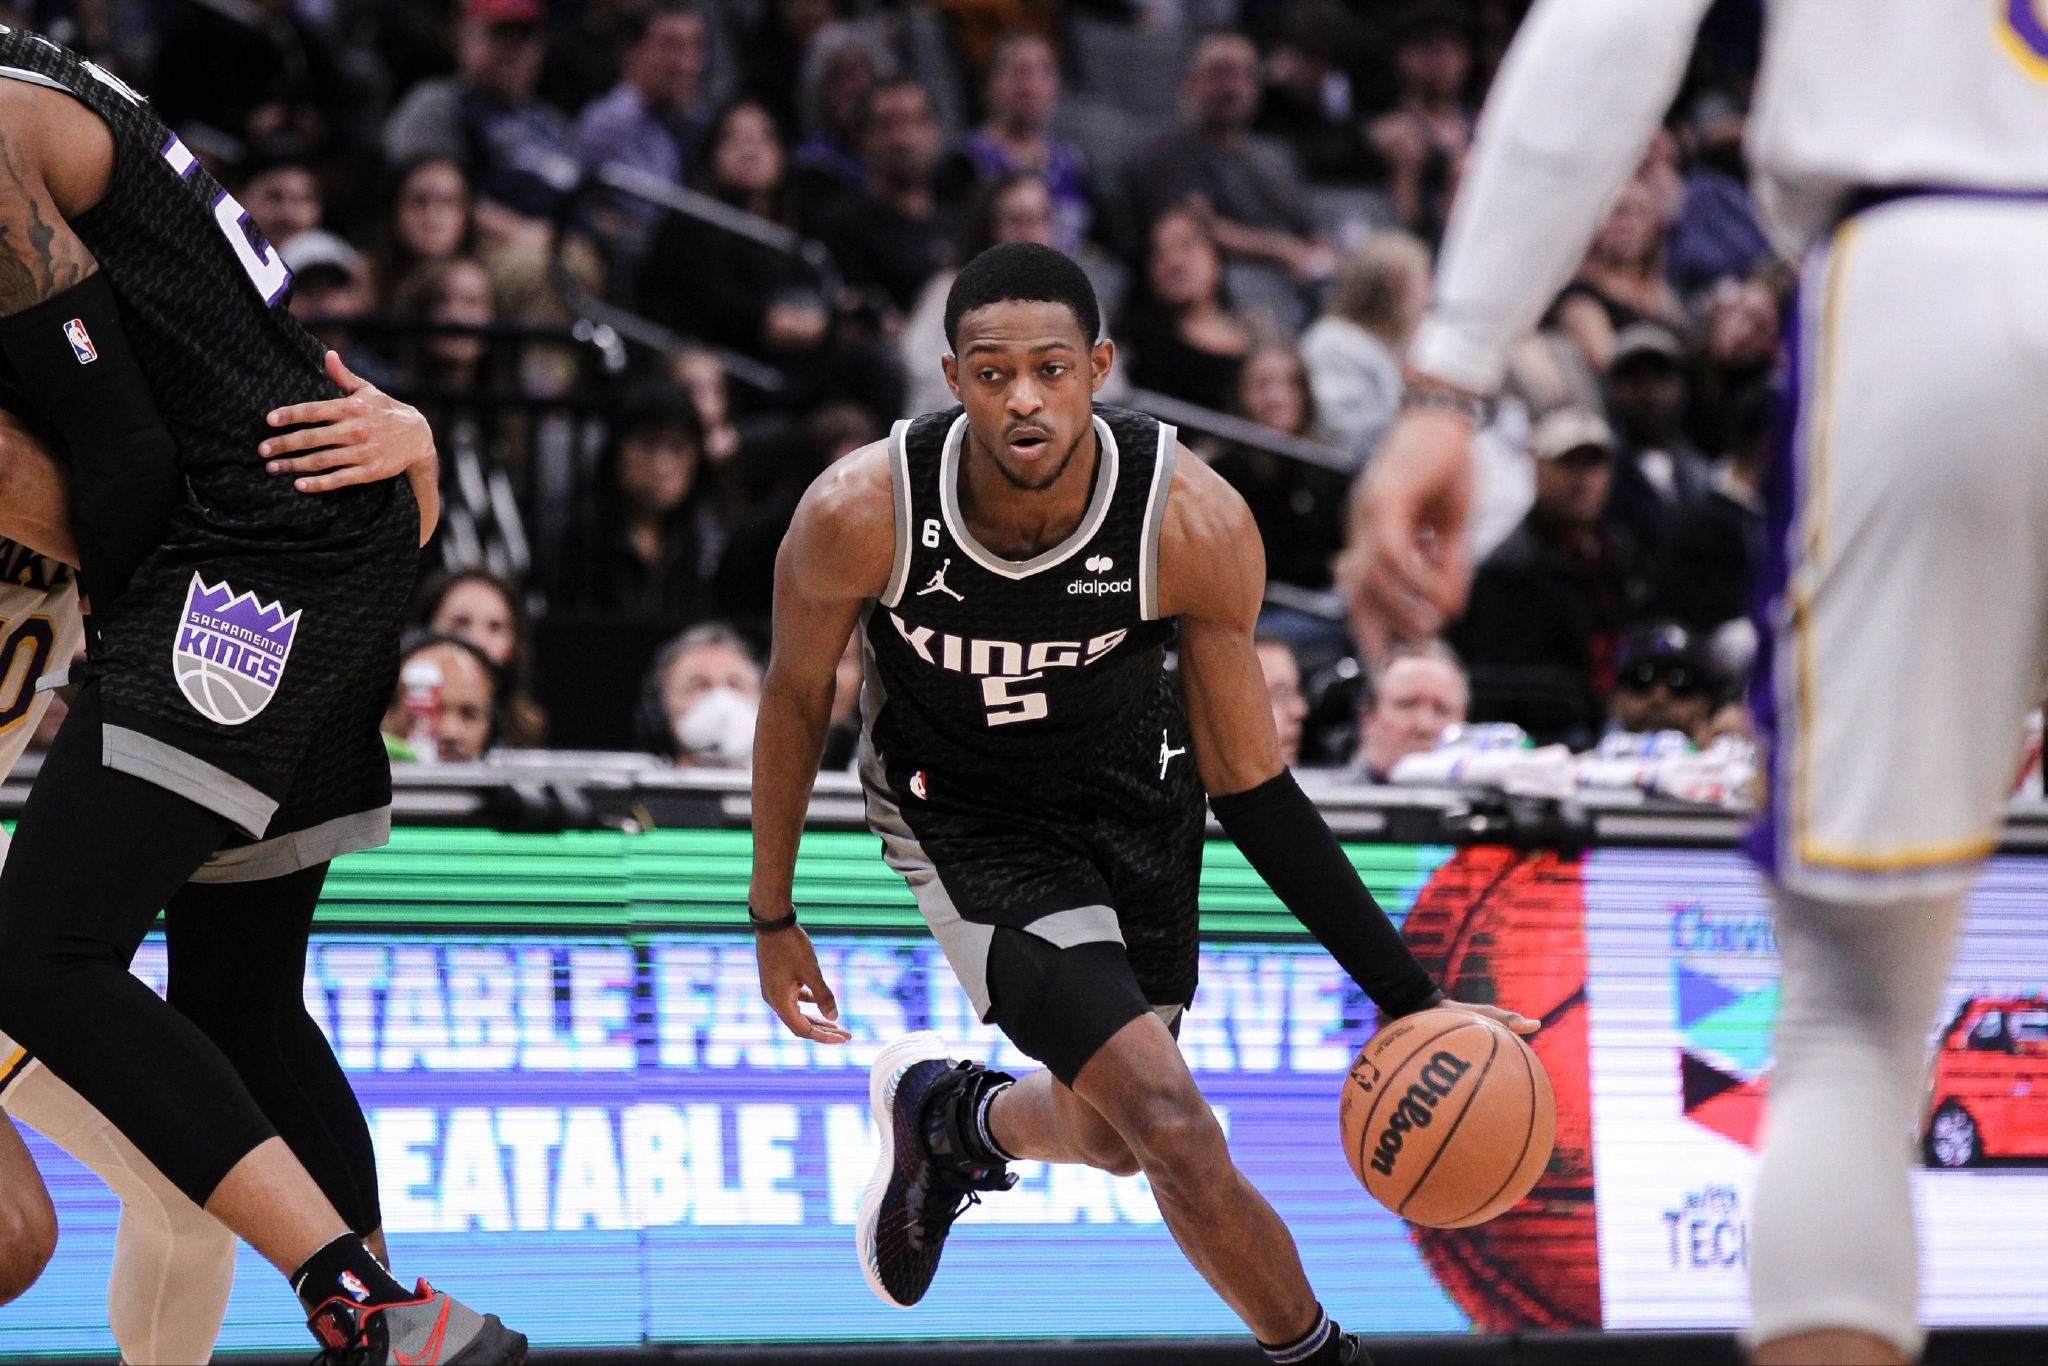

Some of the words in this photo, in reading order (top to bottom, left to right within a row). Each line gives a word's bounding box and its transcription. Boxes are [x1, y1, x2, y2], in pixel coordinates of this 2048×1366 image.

[922, 518, 941, 549] 6
[1067, 577, 1132, 597] dialpad
[178, 626, 282, 688] KINGS
[190, 611, 285, 657] SACRAMENTO
[890, 611, 1128, 676] KINGS
[981, 671, 1048, 727] 5
[1370, 1051, 1471, 1177] Wilson
